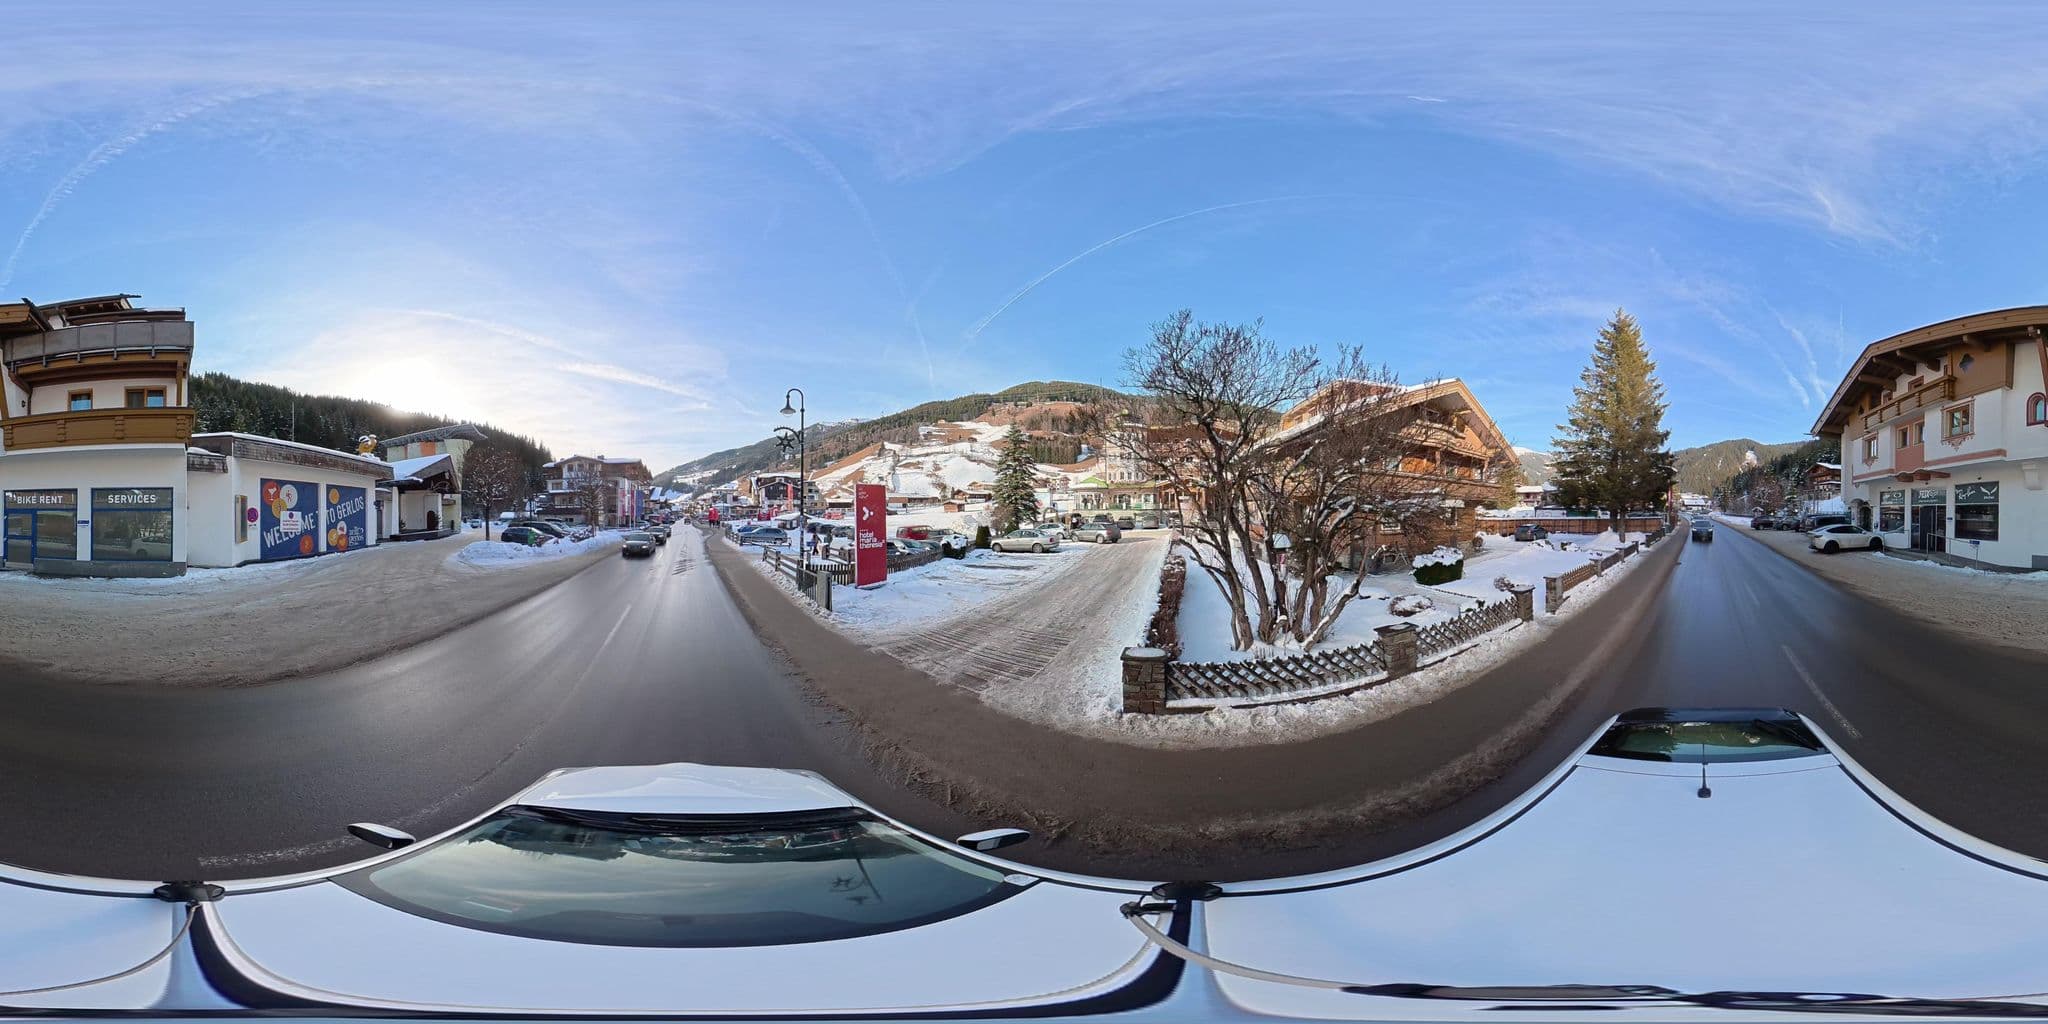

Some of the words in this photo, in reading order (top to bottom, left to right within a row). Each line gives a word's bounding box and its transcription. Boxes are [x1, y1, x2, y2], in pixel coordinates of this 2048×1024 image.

[17, 495, 37, 504] BIKE
[39, 495, 63, 504] RENT
[107, 494, 157, 504] SERVICES
[263, 512, 316, 548] WELME
[336, 496, 364, 519] GERLOS
